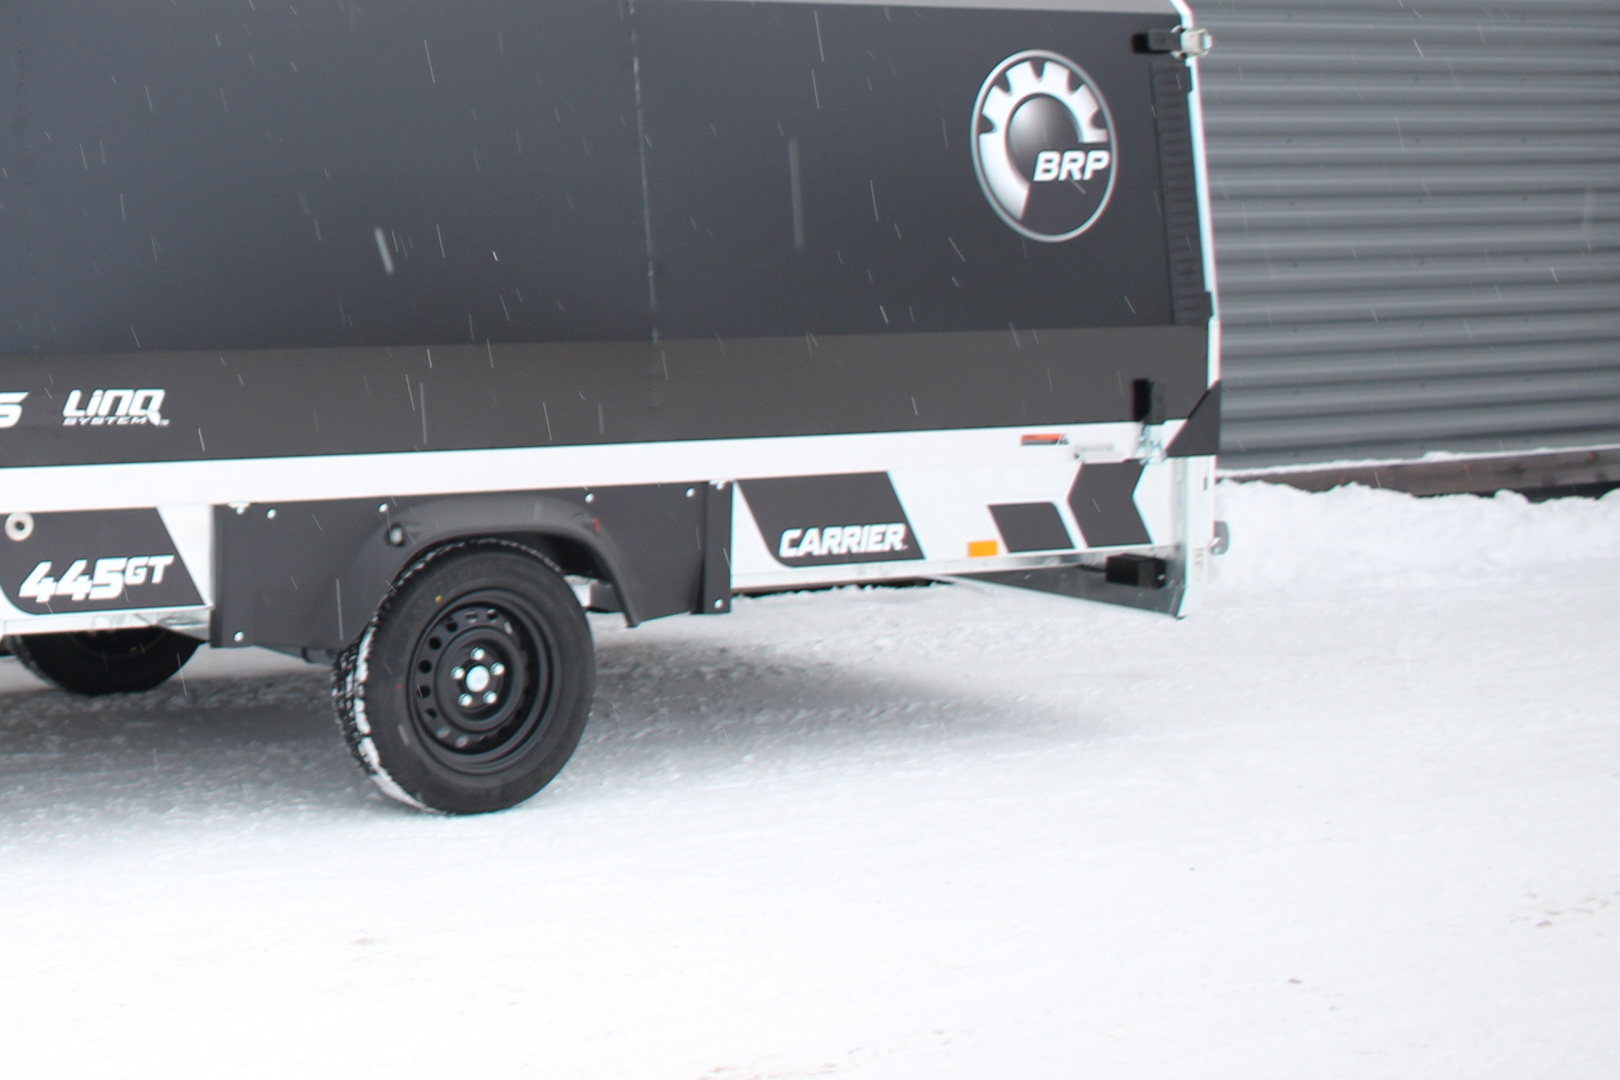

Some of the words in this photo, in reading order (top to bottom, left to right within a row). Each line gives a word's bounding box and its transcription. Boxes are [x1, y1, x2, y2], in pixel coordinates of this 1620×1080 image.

[1032, 149, 1110, 182] BRP
[62, 416, 148, 426] SYSTEM
[778, 522, 907, 558] CARRIER
